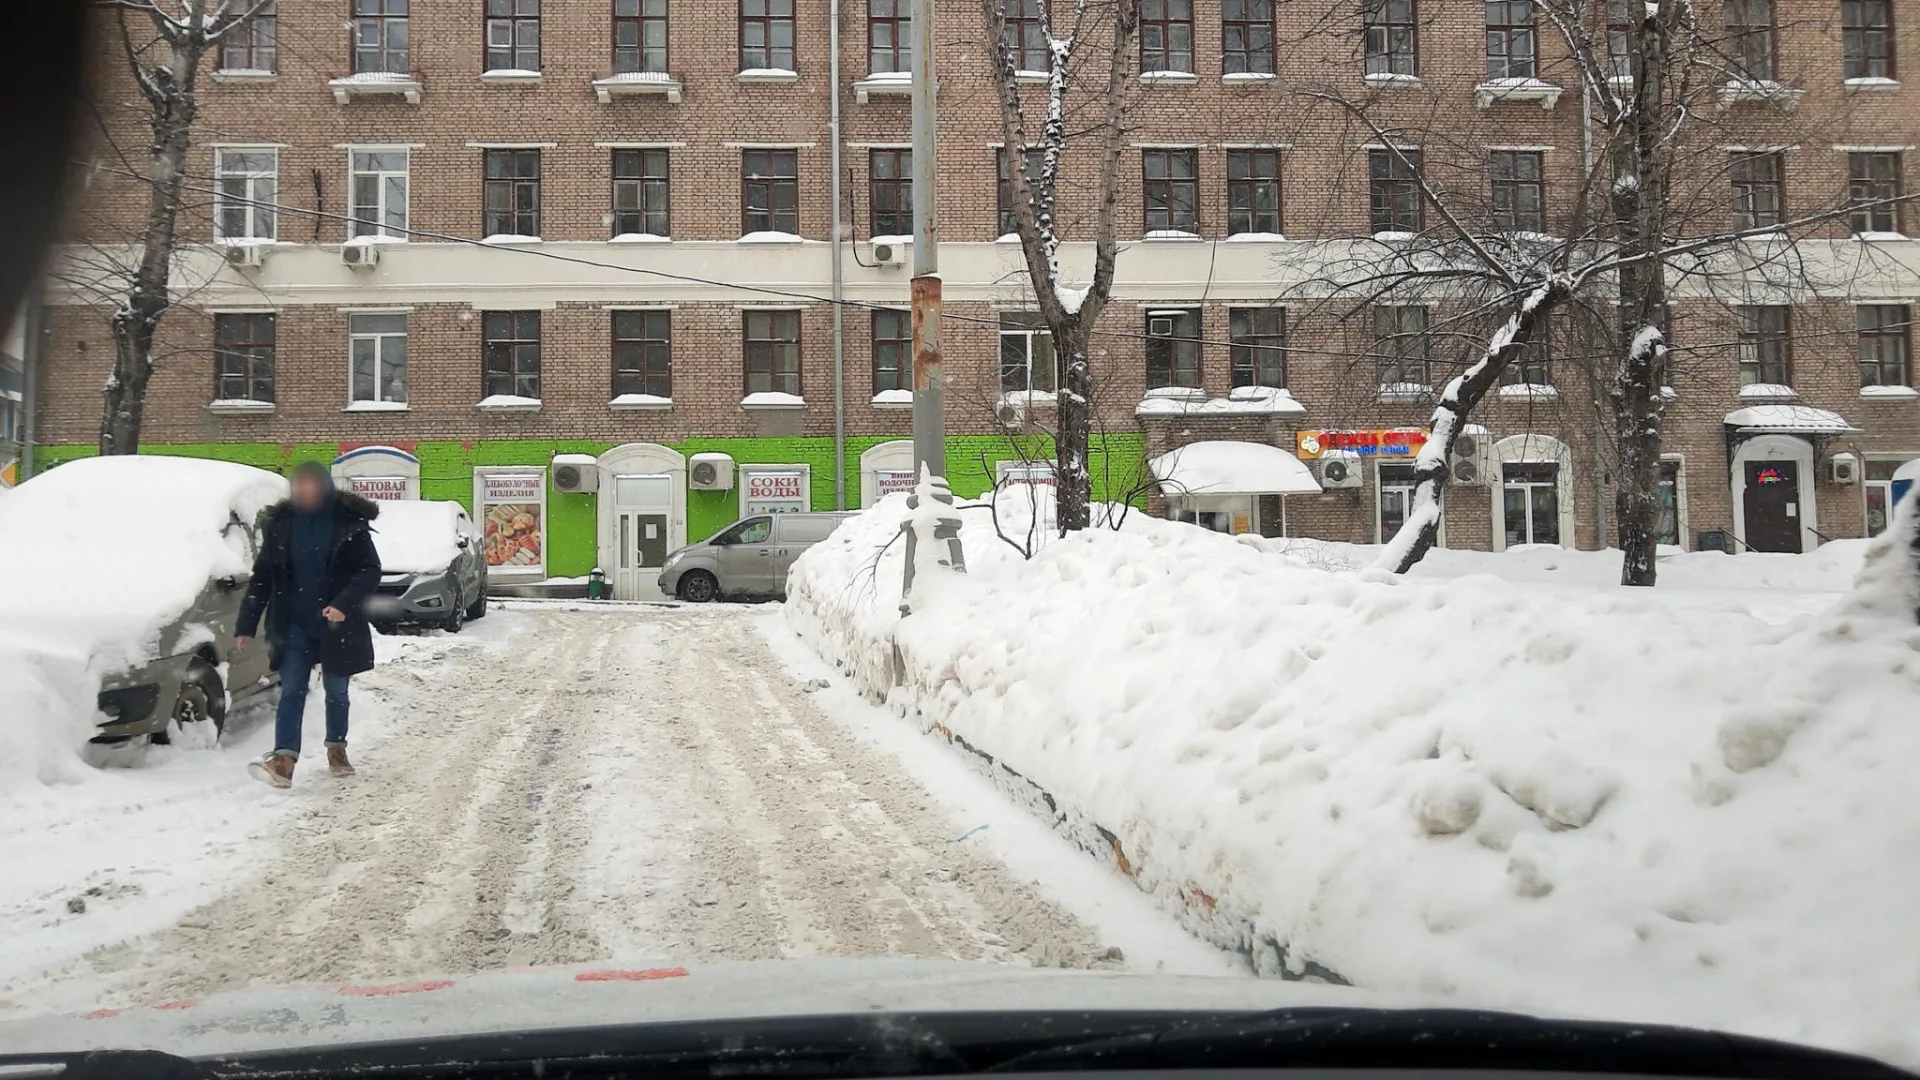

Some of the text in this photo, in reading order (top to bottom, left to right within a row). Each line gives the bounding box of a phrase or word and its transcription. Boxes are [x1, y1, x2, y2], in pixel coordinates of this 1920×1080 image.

[351, 481, 406, 491] БЫТОВАЯ
[750, 477, 799, 487] СОКИ
[750, 488, 801, 498] ВОДЫ
